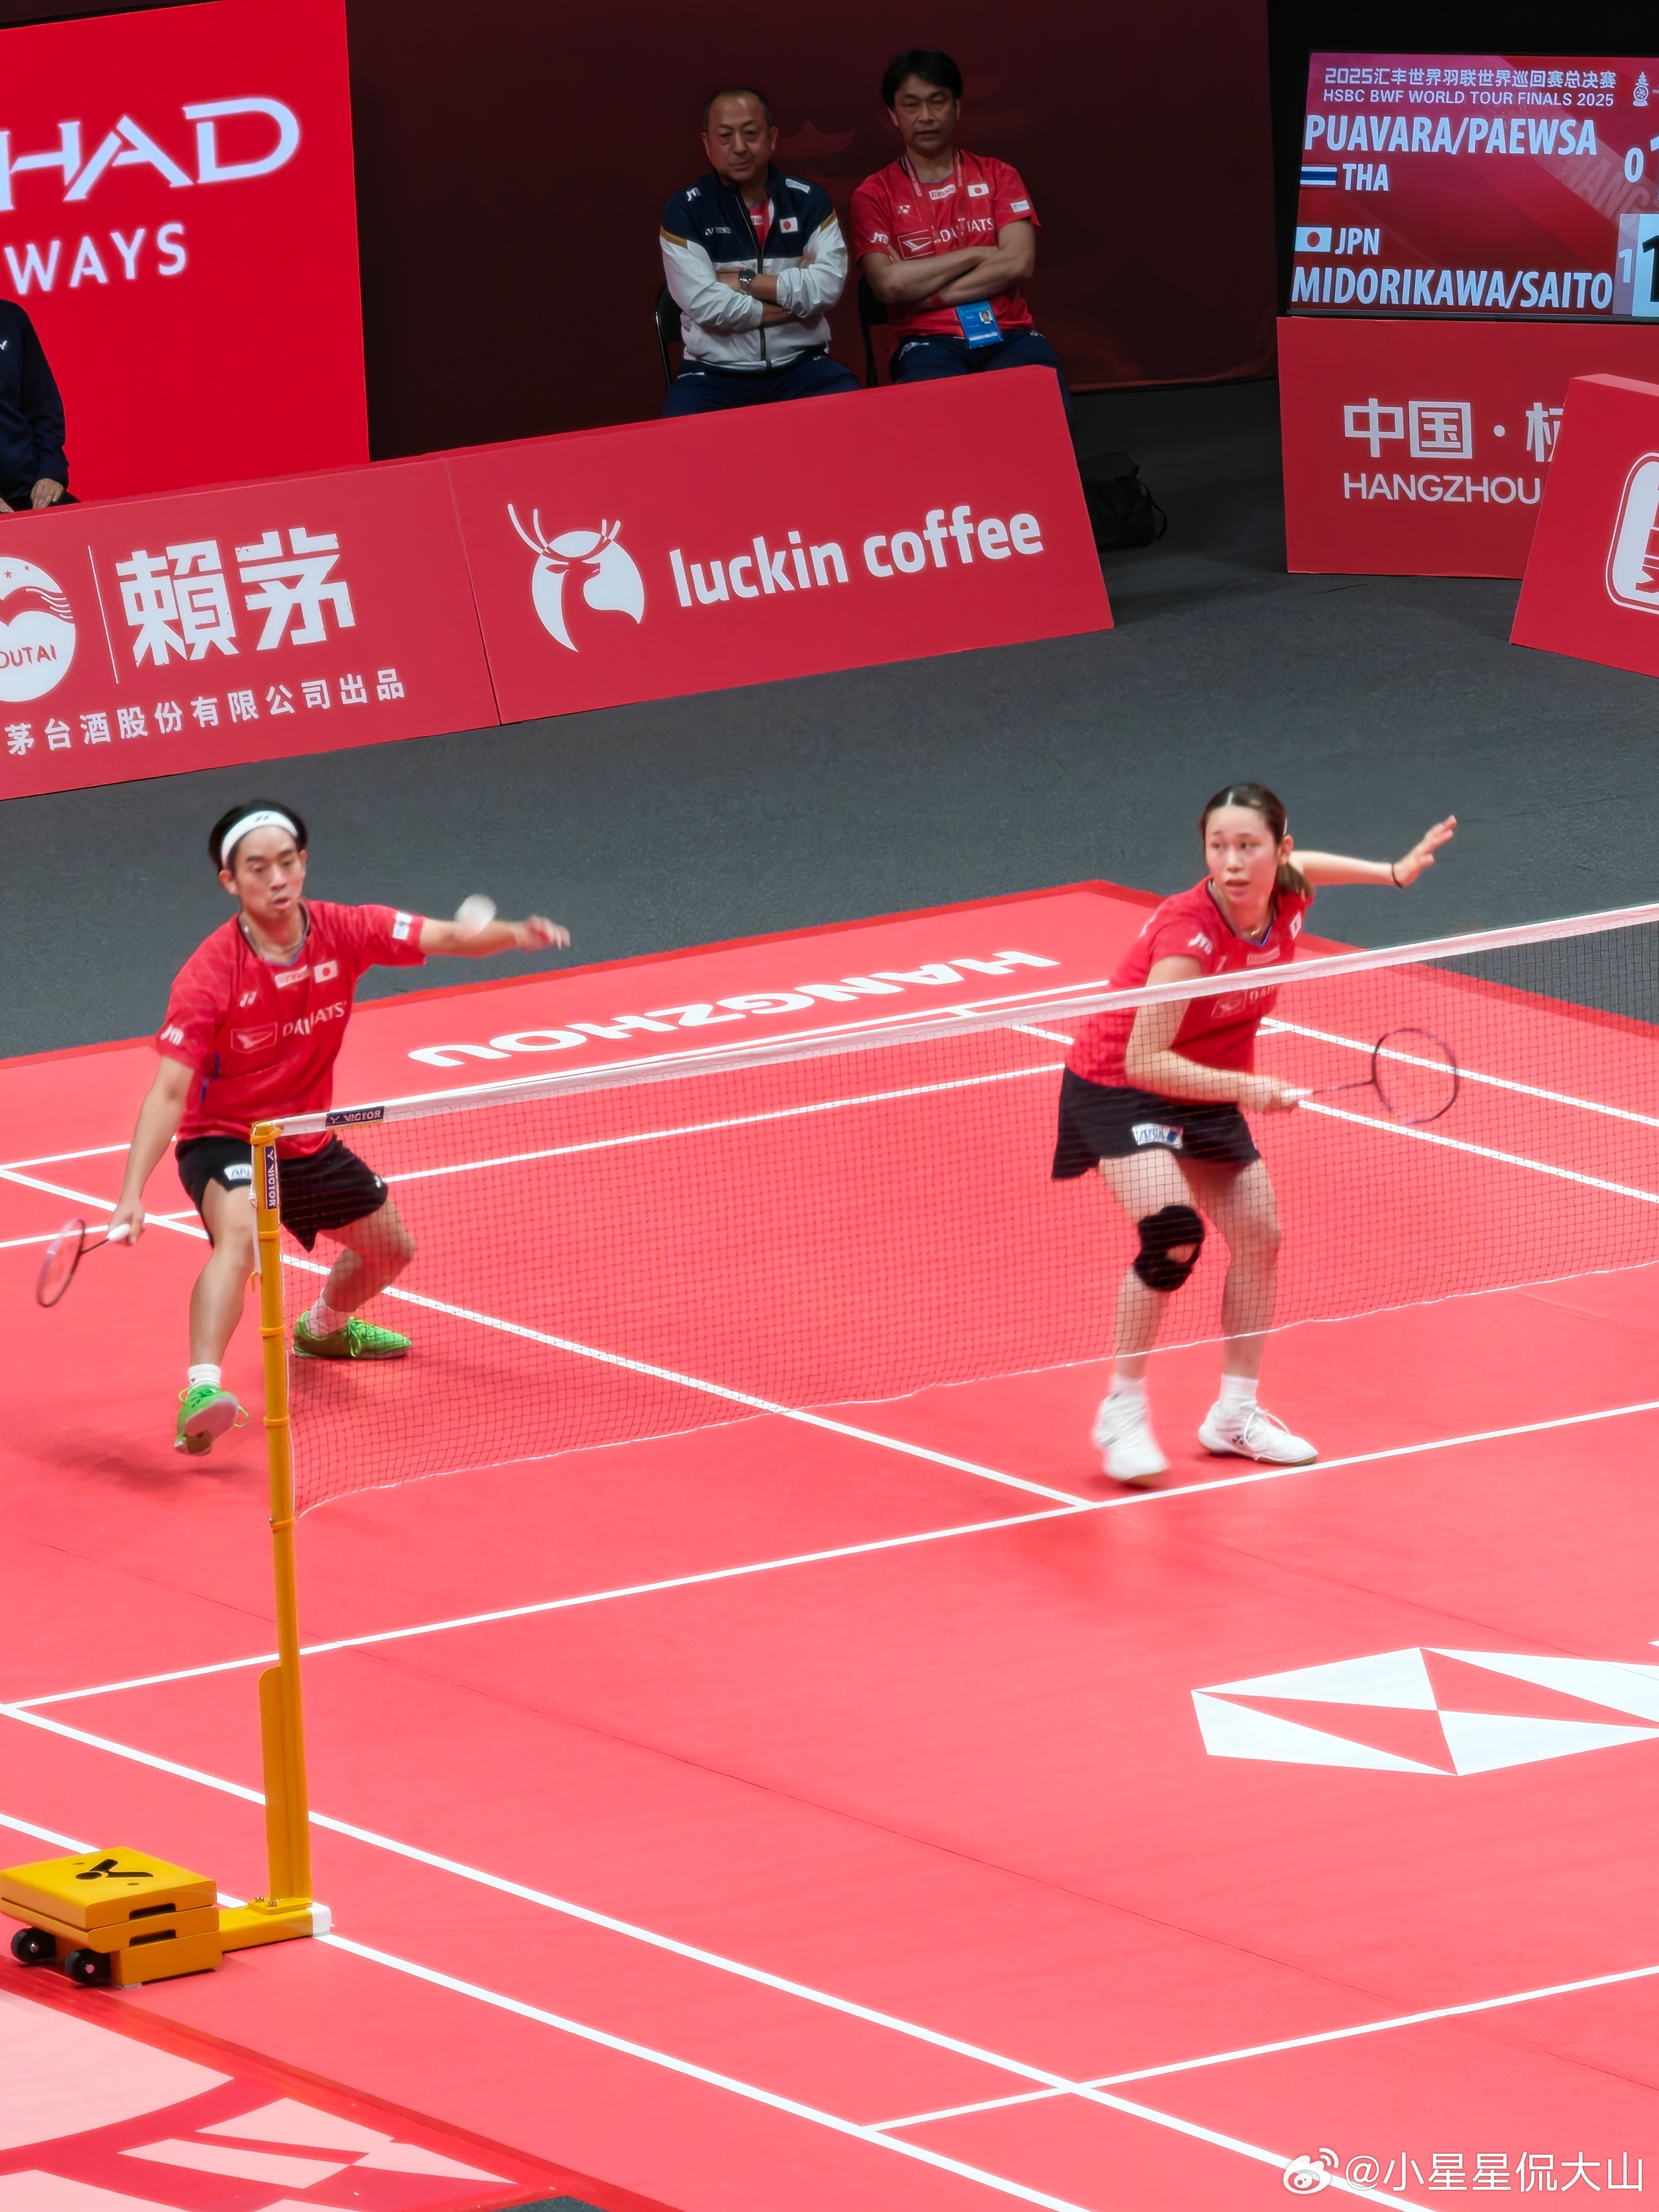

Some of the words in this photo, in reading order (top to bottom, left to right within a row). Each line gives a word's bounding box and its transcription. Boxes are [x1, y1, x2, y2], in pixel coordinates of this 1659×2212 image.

[1323, 89, 1365, 102] HSBC
[1370, 90, 1404, 103] BWF
[1408, 90, 1465, 104] WORLD
[1469, 91, 1513, 105] TOUR
[1517, 92, 1573, 106] FINALS
[1576, 92, 1614, 106] 2025
[1304, 114, 1597, 156] PUAVARA/PAEWSA
[1343, 163, 1389, 191] THA
[1624, 147, 1644, 183] 0
[4, 222, 186, 295] WAYS
[1334, 227, 1380, 255] JPN
[1618, 248, 1633, 283] 1
[1291, 266, 1613, 309] MIDORIKAWA/SAITO
[1343, 473, 1540, 504] HANGZHOU
[669, 530, 849, 607] luckin
[863, 505, 1044, 577] coffee
[5, 669, 405, 756] 茅台酒股份有限公司出品
[408, 951, 1060, 1067] HANGZHOU
